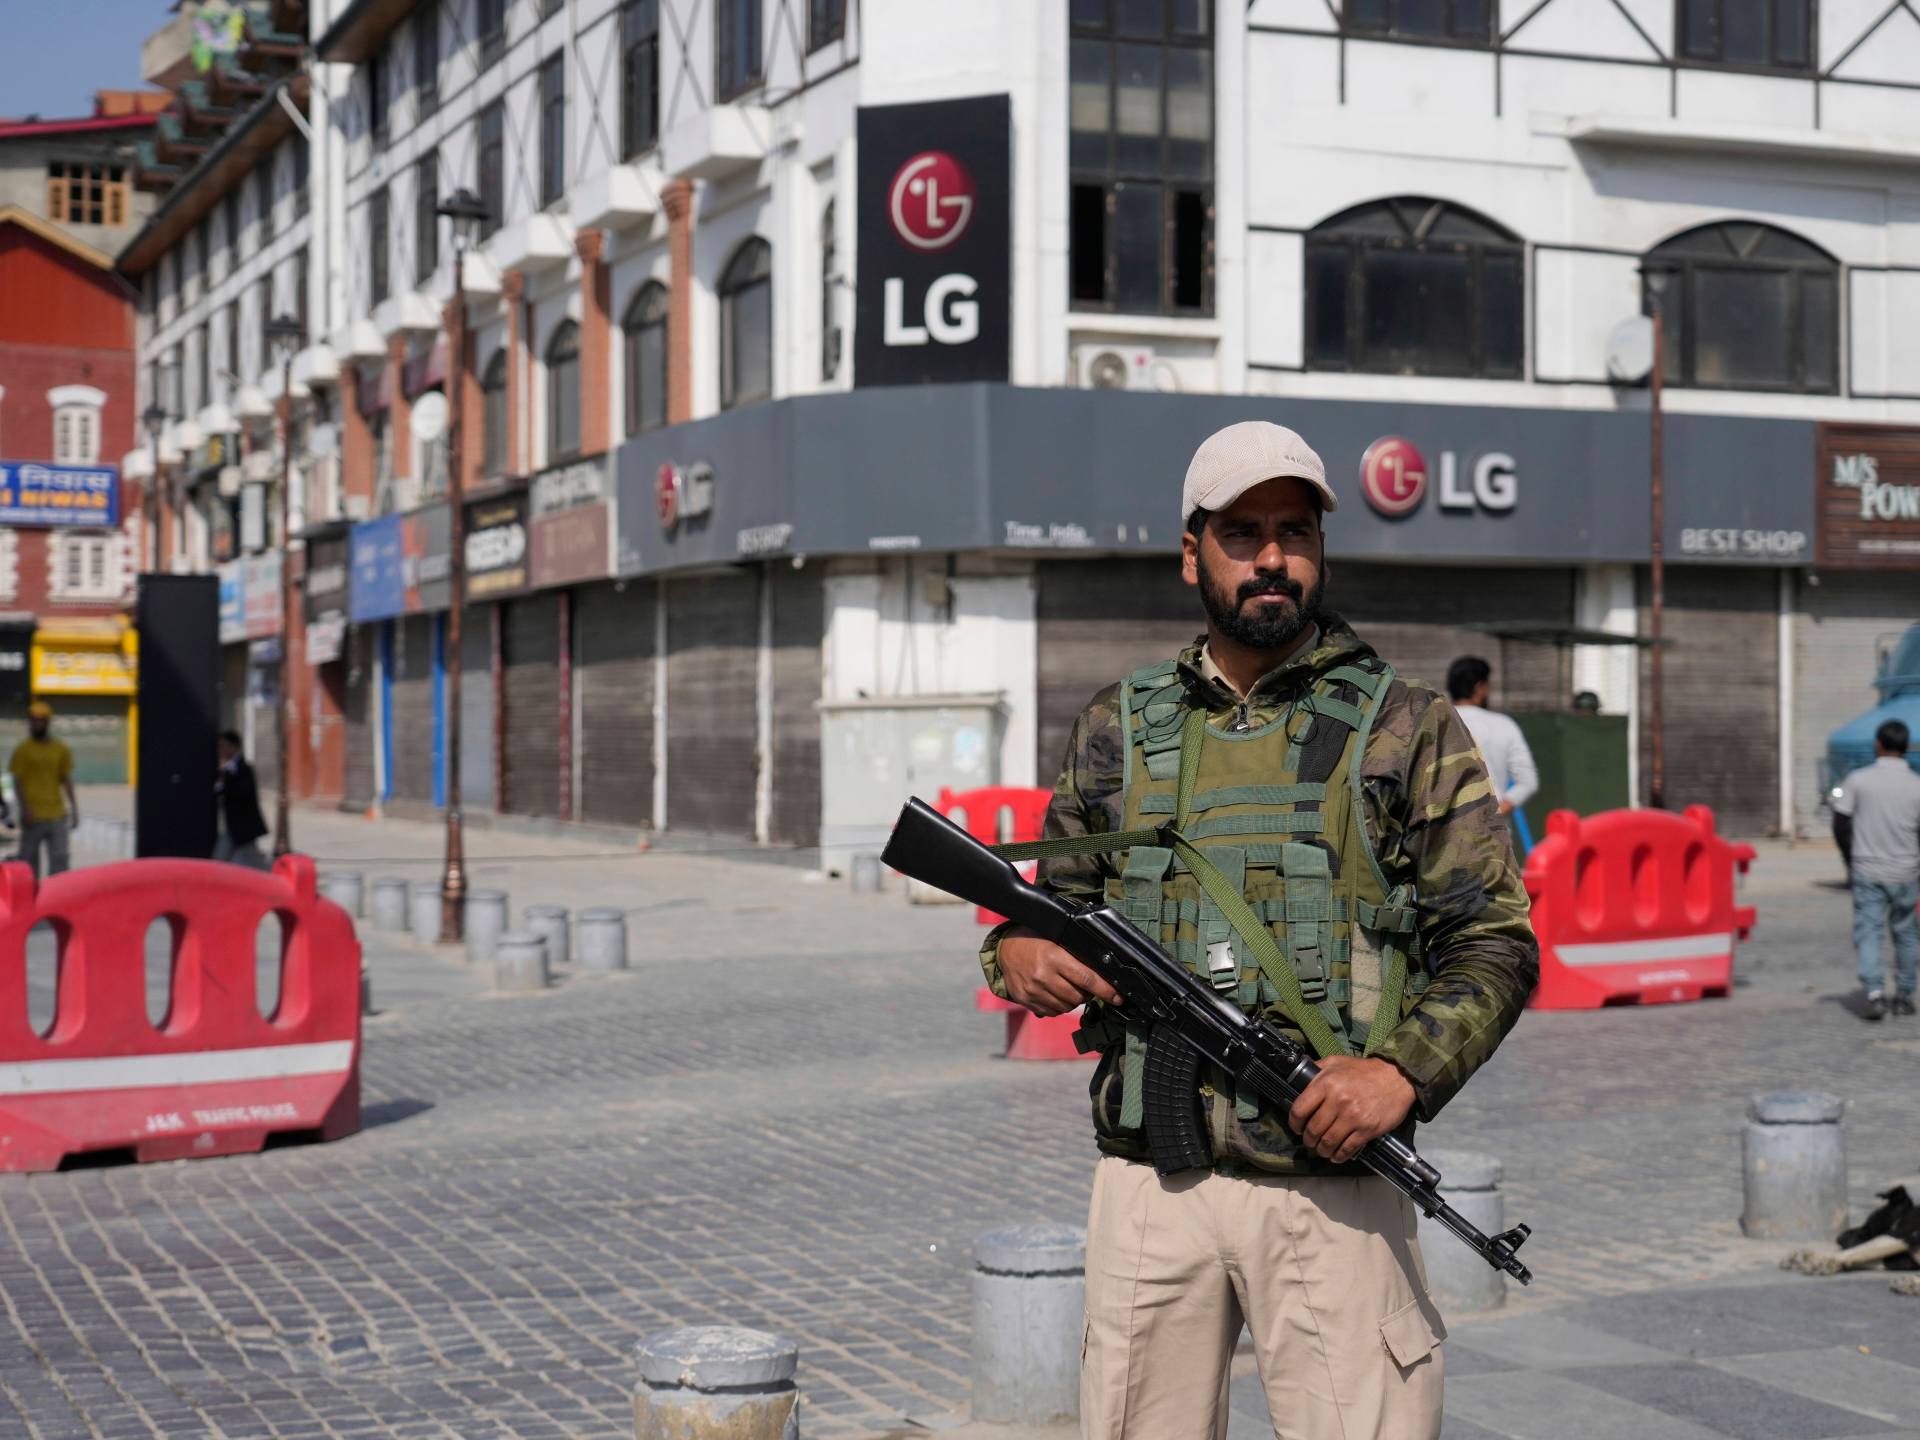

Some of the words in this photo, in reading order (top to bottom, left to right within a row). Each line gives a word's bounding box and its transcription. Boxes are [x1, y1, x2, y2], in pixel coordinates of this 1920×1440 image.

[883, 273, 980, 346] LG
[20, 490, 108, 510] NIWAS
[1439, 450, 1518, 510] LG
[1680, 528, 1738, 552] BEST
[1742, 529, 1807, 554] SHOP
